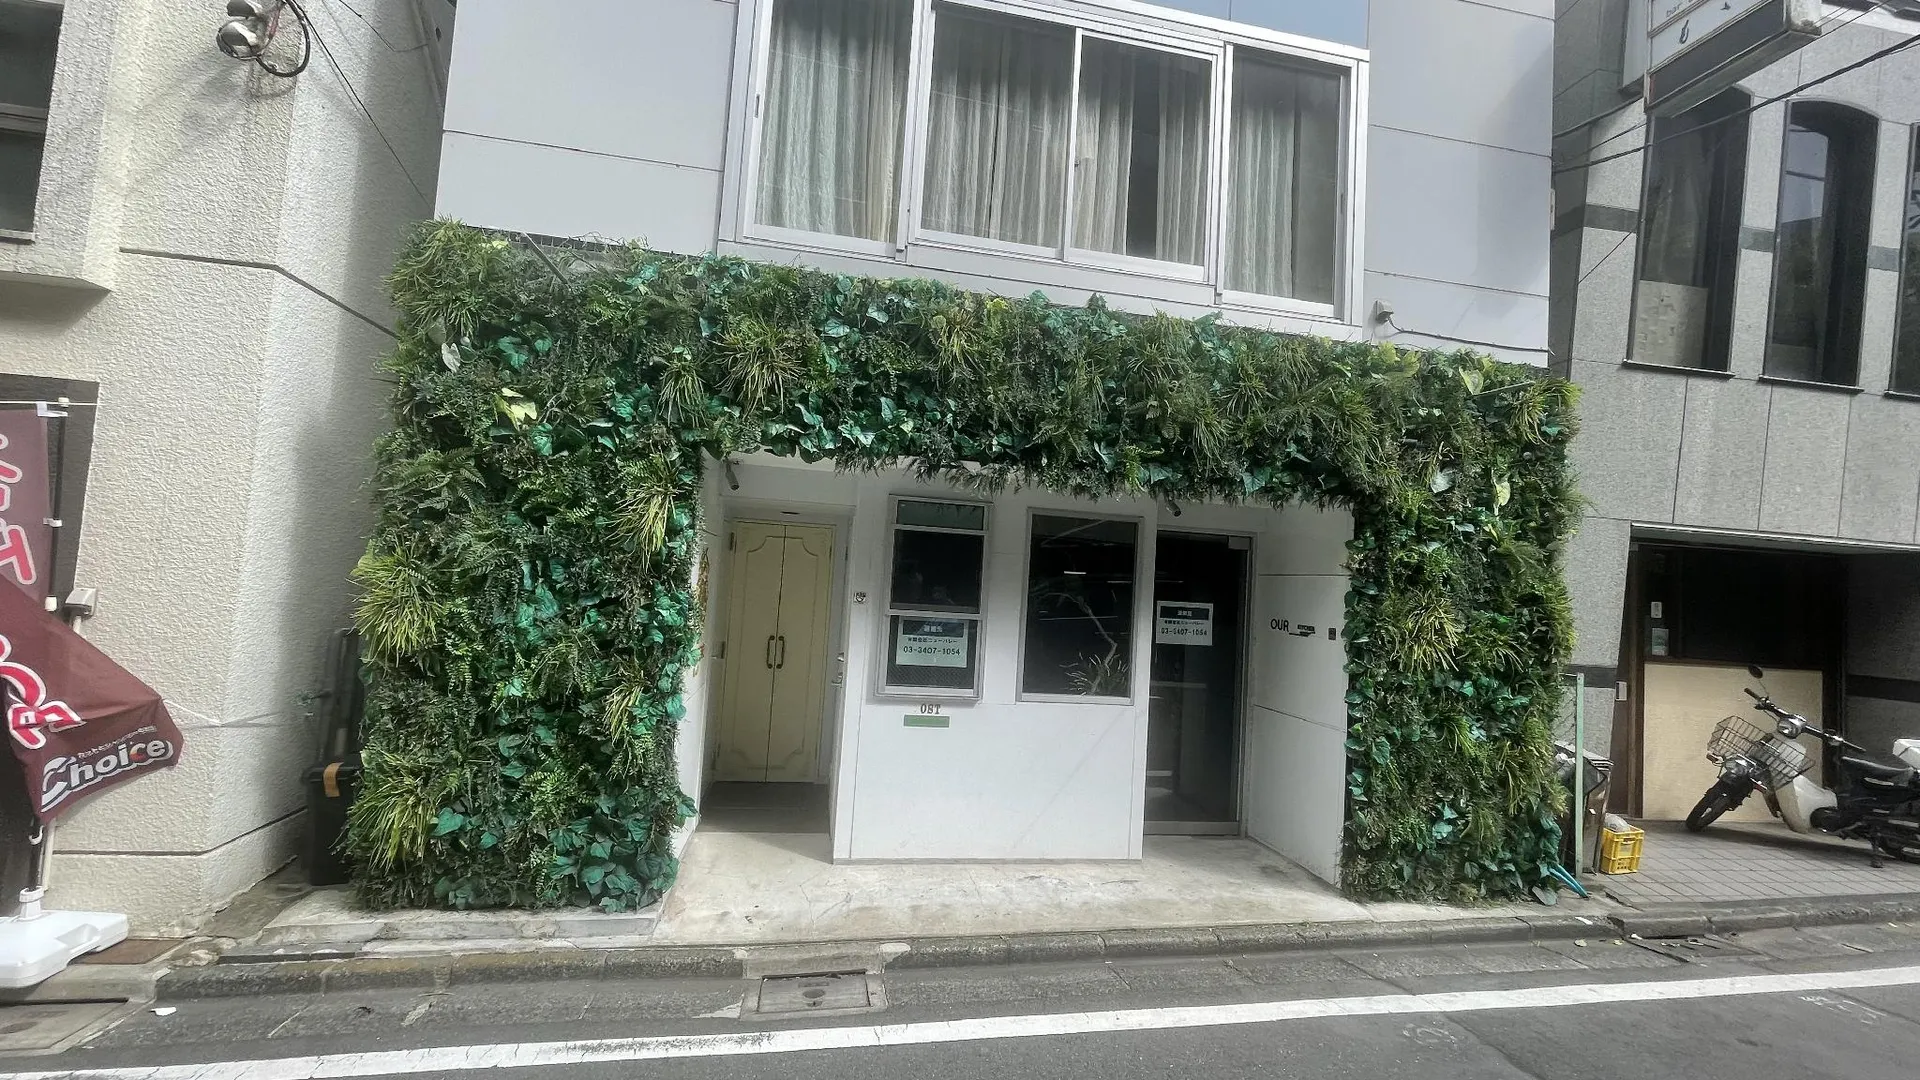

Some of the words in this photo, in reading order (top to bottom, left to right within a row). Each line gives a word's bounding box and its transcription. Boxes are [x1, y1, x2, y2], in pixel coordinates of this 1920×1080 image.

[1270, 618, 1290, 632] OUR
[903, 645, 961, 656] 03-3407-1054
[41, 739, 173, 812] Choice
